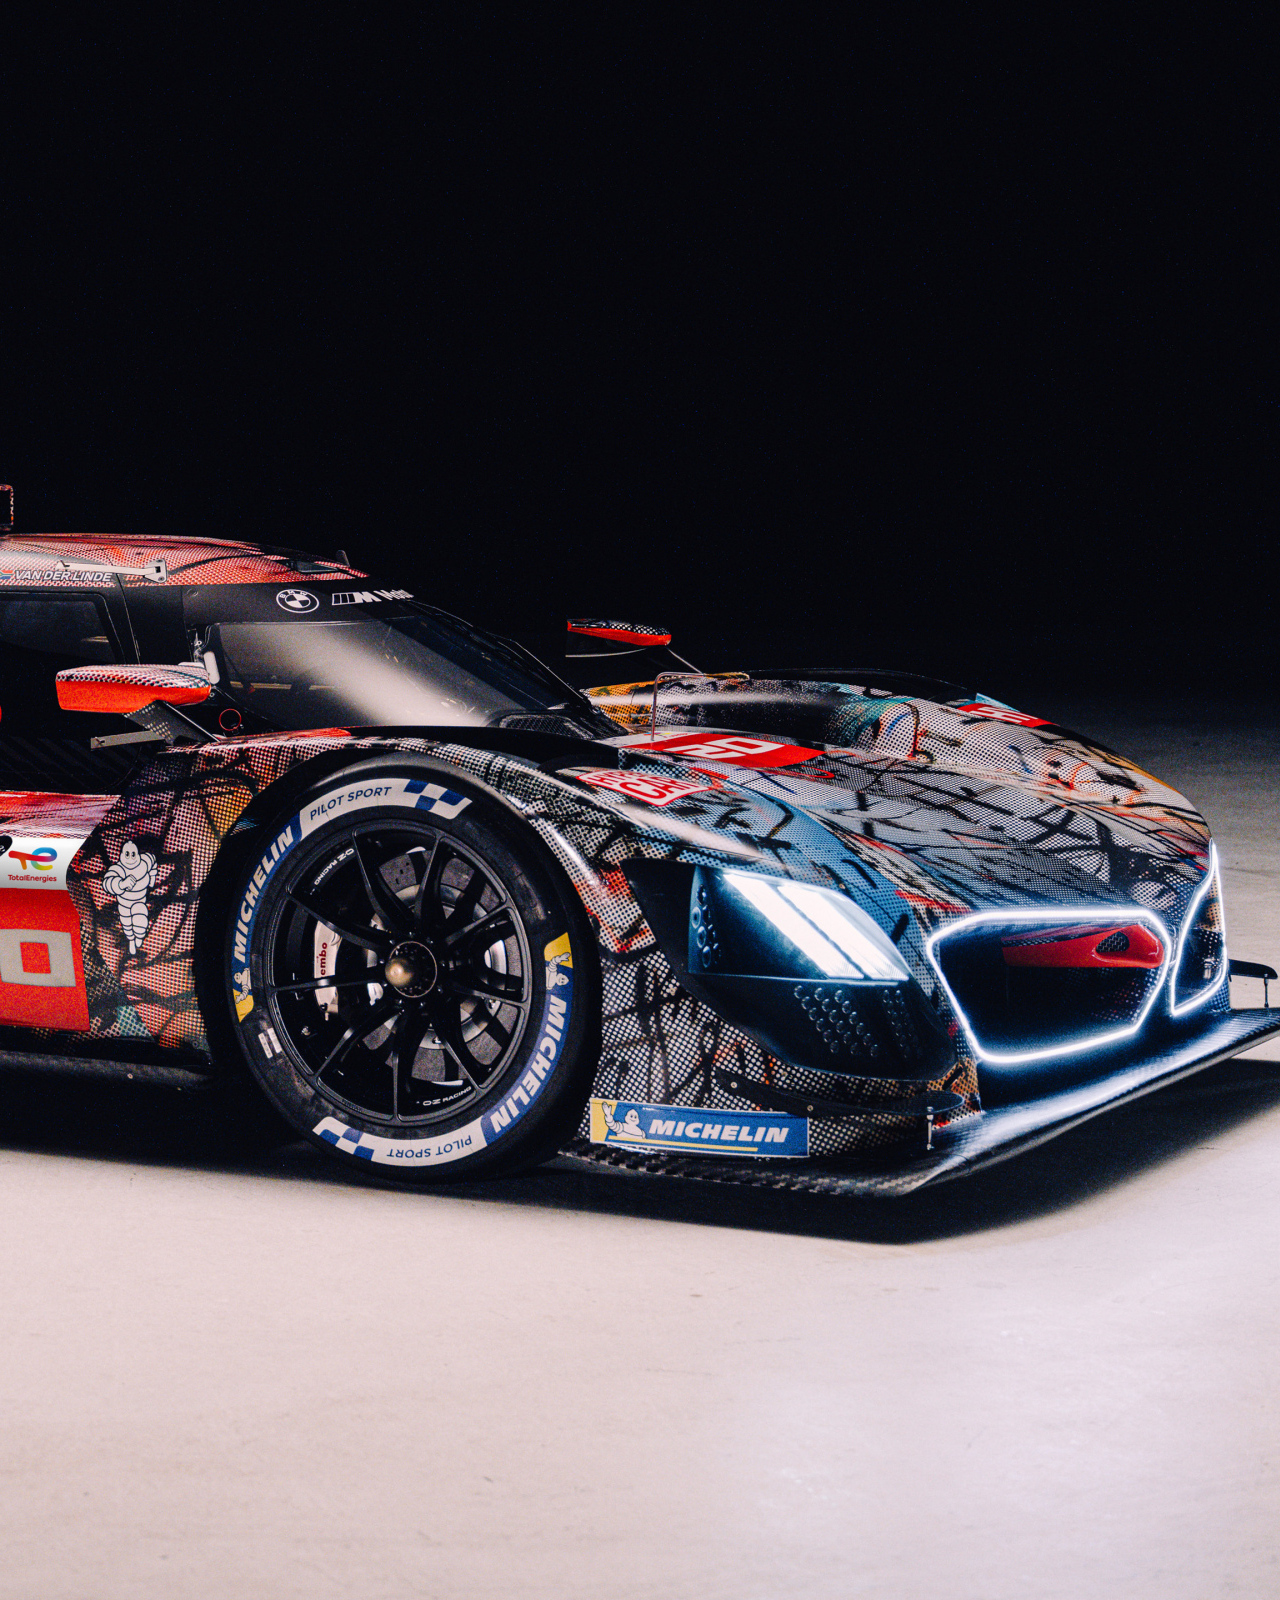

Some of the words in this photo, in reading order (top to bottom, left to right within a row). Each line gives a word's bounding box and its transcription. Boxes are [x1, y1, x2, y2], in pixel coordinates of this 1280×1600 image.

[14, 570, 41, 580] VAN
[43, 570, 71, 581] DER
[72, 571, 113, 582] LINDE
[663, 737, 786, 760] 20
[618, 776, 700, 799] CAR
[310, 795, 345, 821] PILOT
[347, 786, 393, 802] SPORT
[8, 874, 57, 883] TotalEnergies
[234, 825, 294, 964] MICHELIN
[319, 942, 328, 976] embo
[490, 994, 568, 1134] MICHELIN
[649, 1119, 789, 1143] MICHELIN
[386, 1147, 432, 1159] SPORT
[436, 1134, 473, 1156] PILOT
